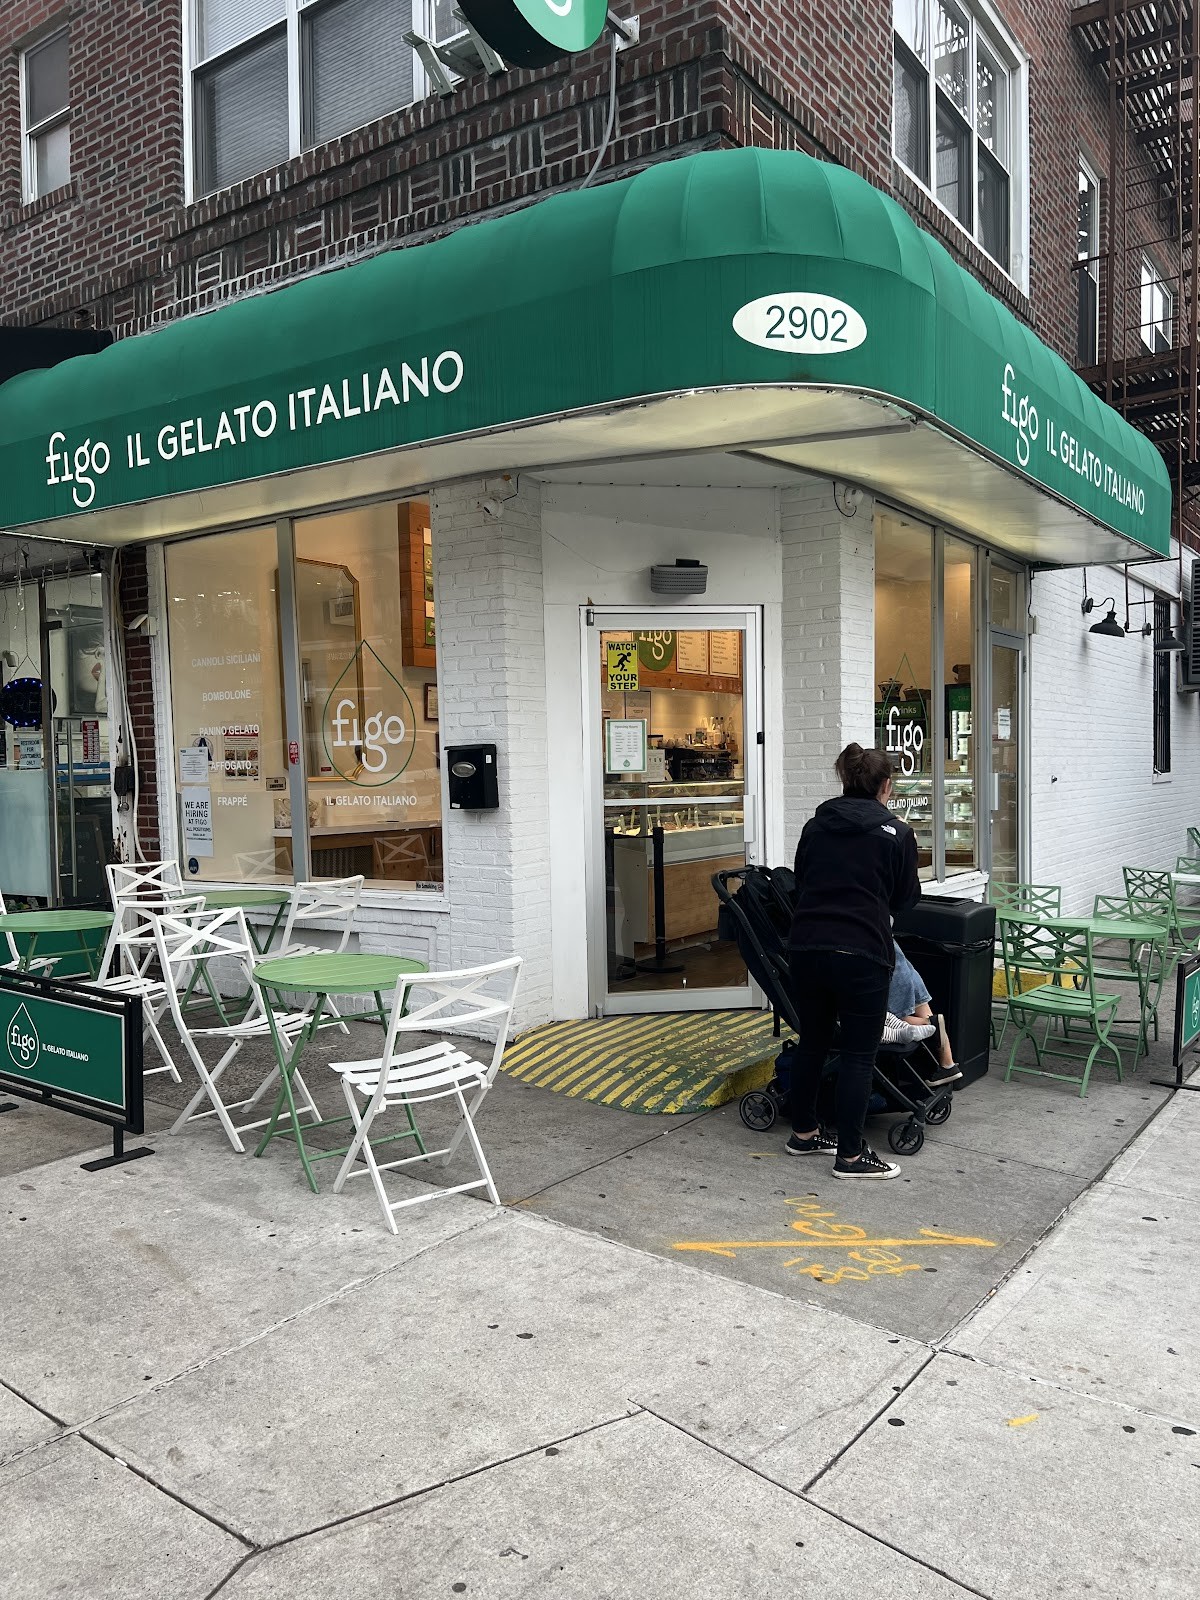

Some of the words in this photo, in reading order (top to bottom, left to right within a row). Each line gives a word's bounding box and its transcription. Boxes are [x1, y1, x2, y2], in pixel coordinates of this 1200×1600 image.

[765, 304, 848, 344] 2902
[45, 431, 111, 509] figo
[126, 433, 151, 469] IL
[157, 400, 277, 460] GELATO
[287, 350, 465, 431] ITALIANO
[1001, 362, 1039, 467] figo
[1046, 418, 1057, 457] IL
[1059, 430, 1102, 488] GELATO
[1104, 463, 1145, 516] ITALIANO
[608, 643, 637, 651] WATCH
[191, 656, 224, 668] CANNOLI
[226, 653, 260, 665] SICILIANI
[609, 673, 637, 682] YOUR
[609, 682, 636, 690] STEP
[202, 689, 251, 701] BOMBOLONE
[892, 706, 917, 715] rinks
[199, 726, 227, 737] PANINO
[228, 724, 260, 735] GELATO
[331, 698, 406, 773] figo
[885, 705, 924, 777] figo
[210, 760, 252, 771] AFFOGATO
[184, 801, 194, 809] WE
[195, 801, 209, 809] ARE
[217, 794, 248, 807] FRAPPÉ
[326, 796, 334, 806] IL
[335, 796, 371, 806] GELATO
[373, 795, 417, 806] ITALIANO
[886, 799, 906, 810] GELATO
[907, 796, 928, 808] ITALIANO
[185, 810, 208, 818] HIRING
[194, 818, 207, 826] FIGO
[10, 1024, 36, 1061] figo
[42, 1043, 47, 1051] IL
[47, 1045, 66, 1056] GELATO
[66, 1048, 89, 1062] ITALIANO
